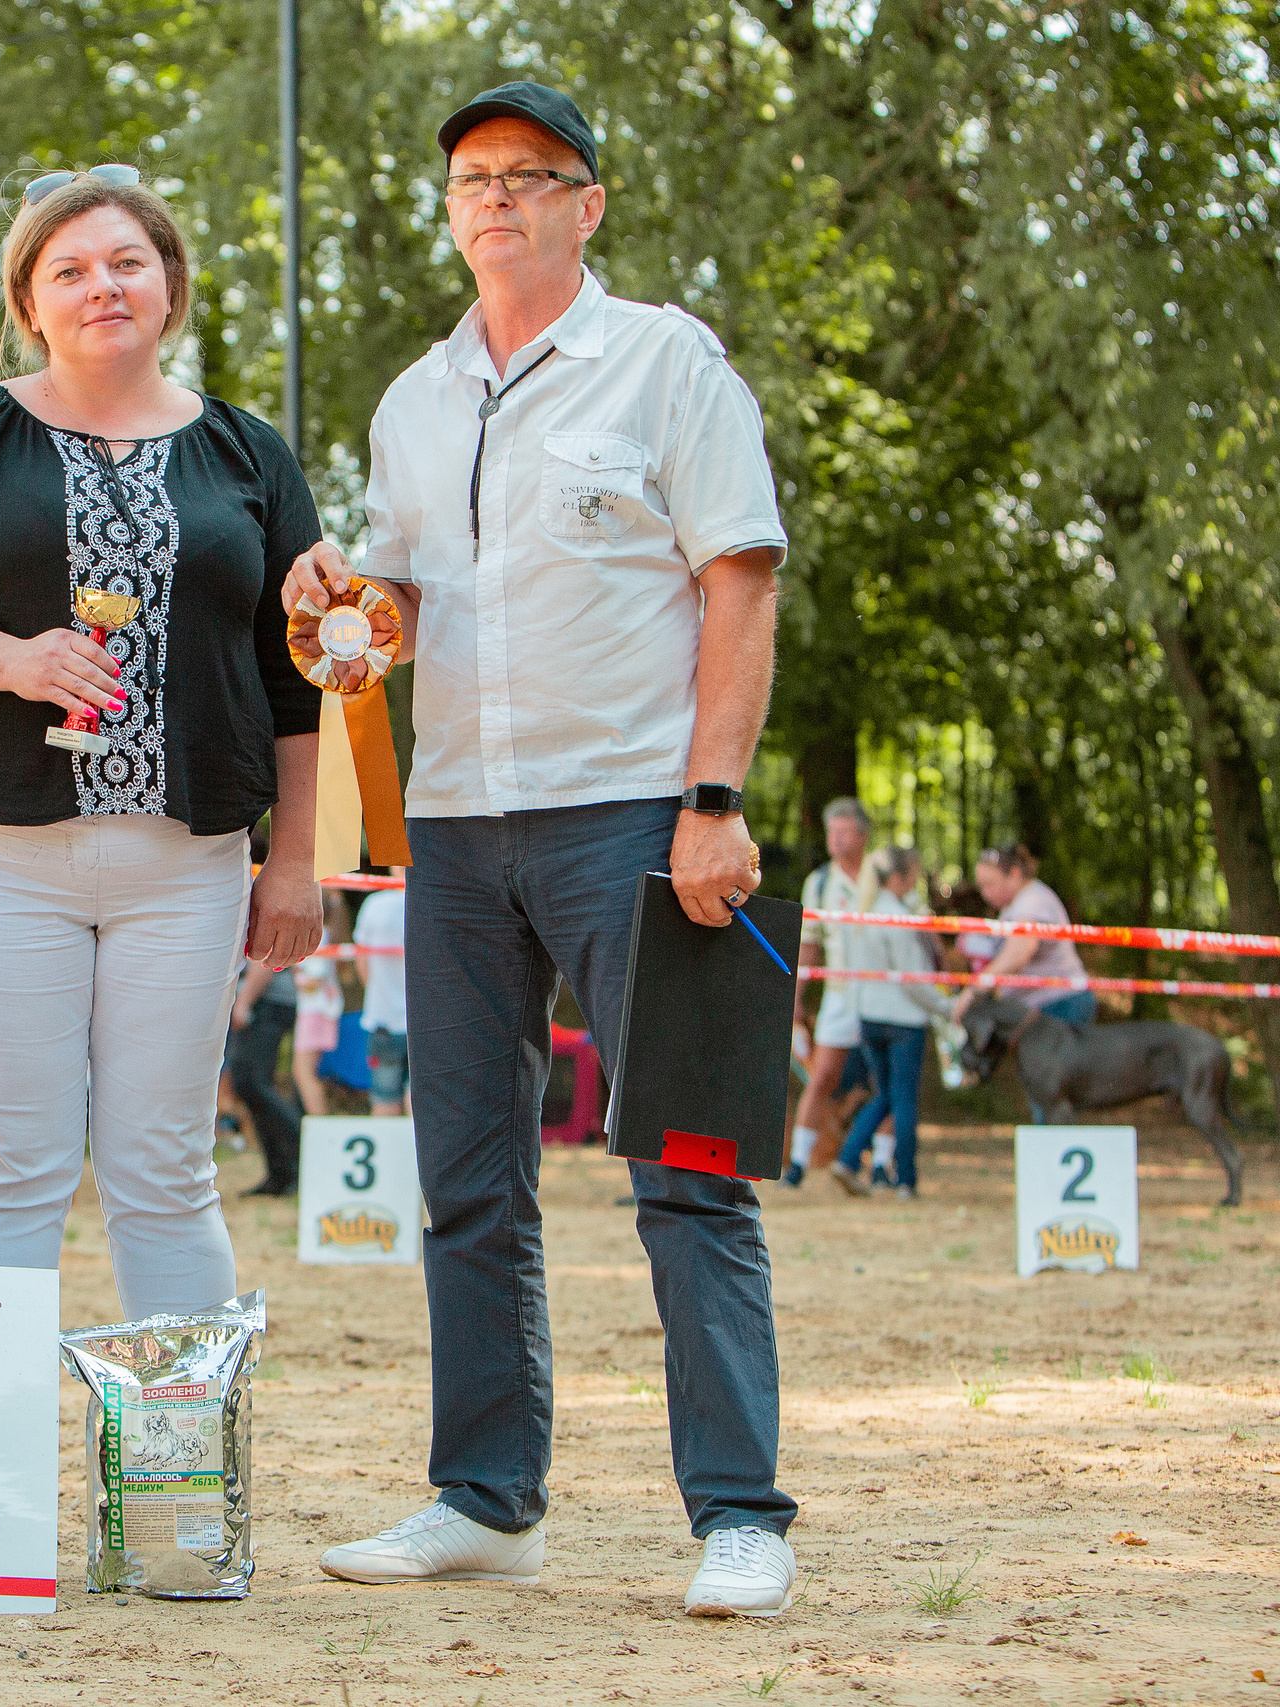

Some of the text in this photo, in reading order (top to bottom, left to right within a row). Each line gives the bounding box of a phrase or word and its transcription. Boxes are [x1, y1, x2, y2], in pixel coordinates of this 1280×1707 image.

[560, 486, 622, 500] UNIVERSITY
[344, 1136, 376, 1191] 3
[1061, 1148, 1097, 1201] 2
[1038, 1224, 1116, 1266] Nutro
[143, 1386, 205, 1399] ЗООМЕНЮ
[124, 1403, 157, 1411] УНИКАЛЬНЫЕ
[106, 1384, 122, 1548] ПРОФЕССИОНАЛ
[124, 1484, 164, 1492] МЕДИУМ
[192, 1478, 218, 1486] 26/15
